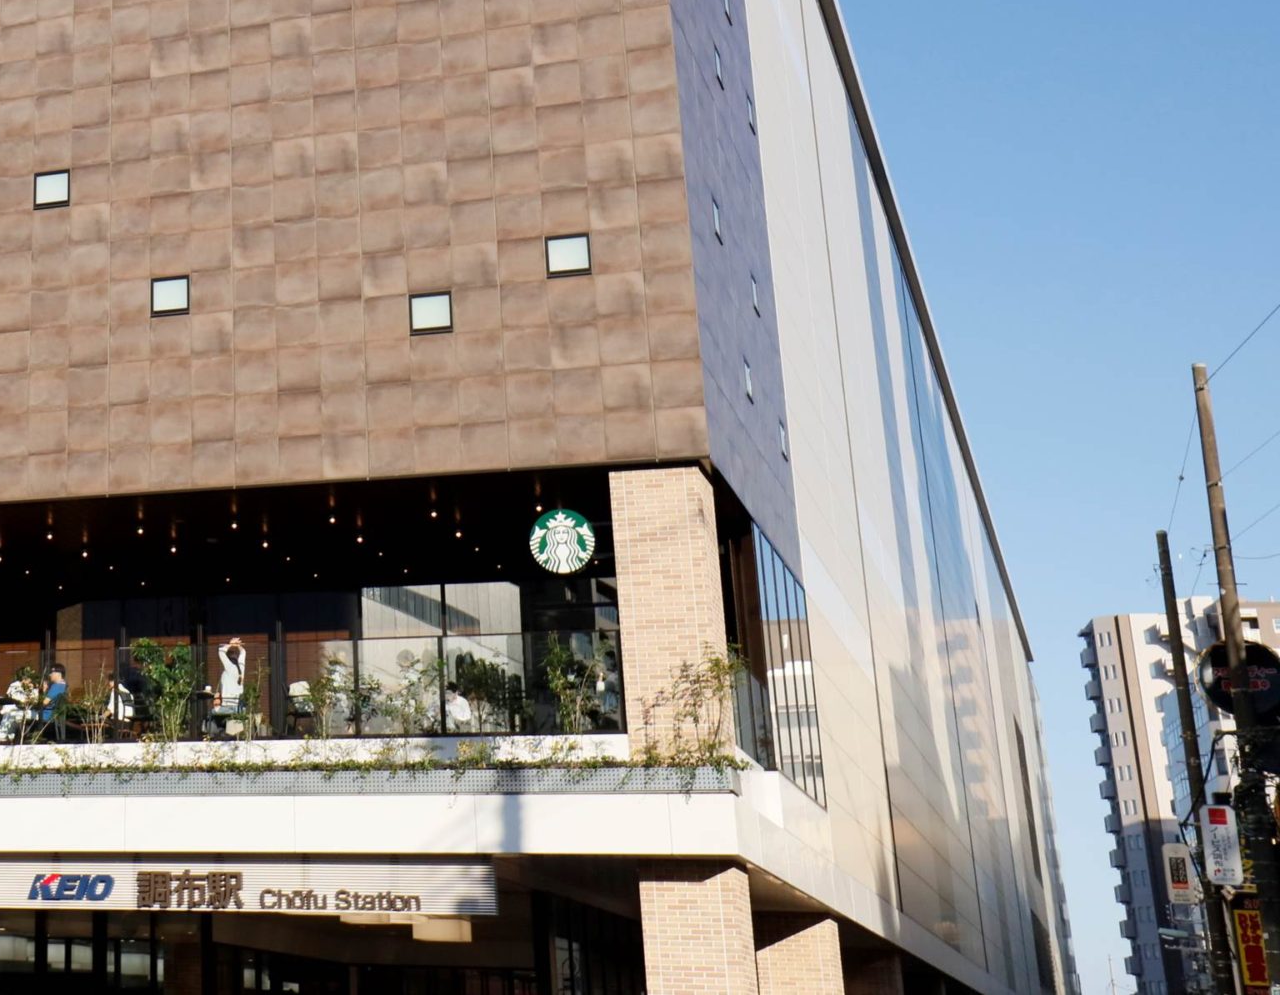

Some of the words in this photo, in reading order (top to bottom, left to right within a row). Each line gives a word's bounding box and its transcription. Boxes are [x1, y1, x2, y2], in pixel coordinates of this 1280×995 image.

[28, 873, 115, 901] KEIO
[136, 869, 244, 909] 調布駅
[334, 889, 421, 912] Station
